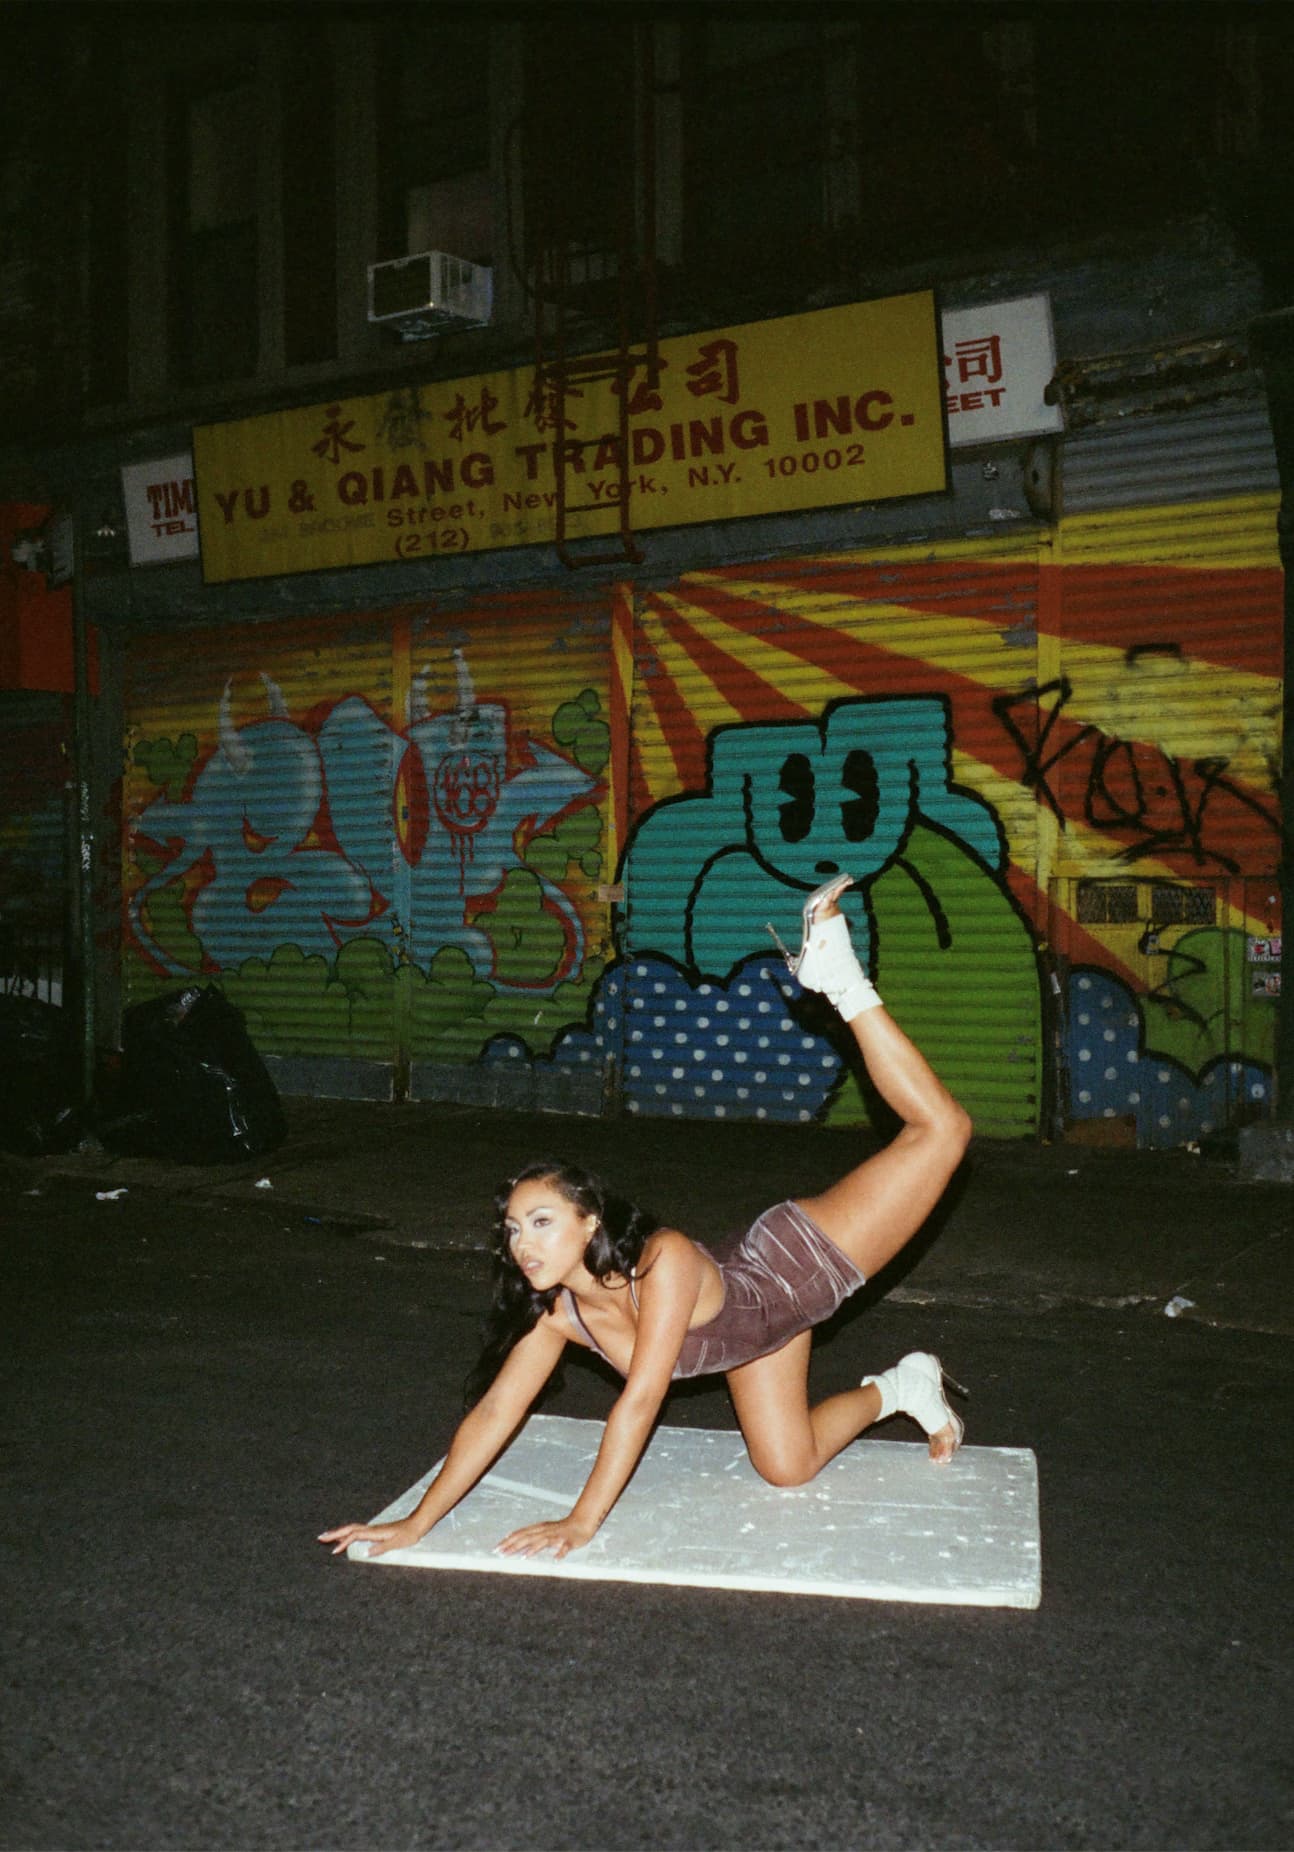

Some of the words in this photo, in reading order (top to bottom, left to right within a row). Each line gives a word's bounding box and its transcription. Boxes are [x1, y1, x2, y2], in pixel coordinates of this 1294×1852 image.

[214, 484, 271, 524] YU
[288, 480, 317, 513] &
[338, 452, 495, 510] QIANG
[515, 410, 769, 480] TRADING
[794, 390, 915, 442] INC.
[386, 502, 485, 527] Street,
[586, 474, 668, 500] York,
[688, 462, 741, 489] N.Y.
[766, 443, 866, 479] 10002
[394, 526, 470, 556] (212)
